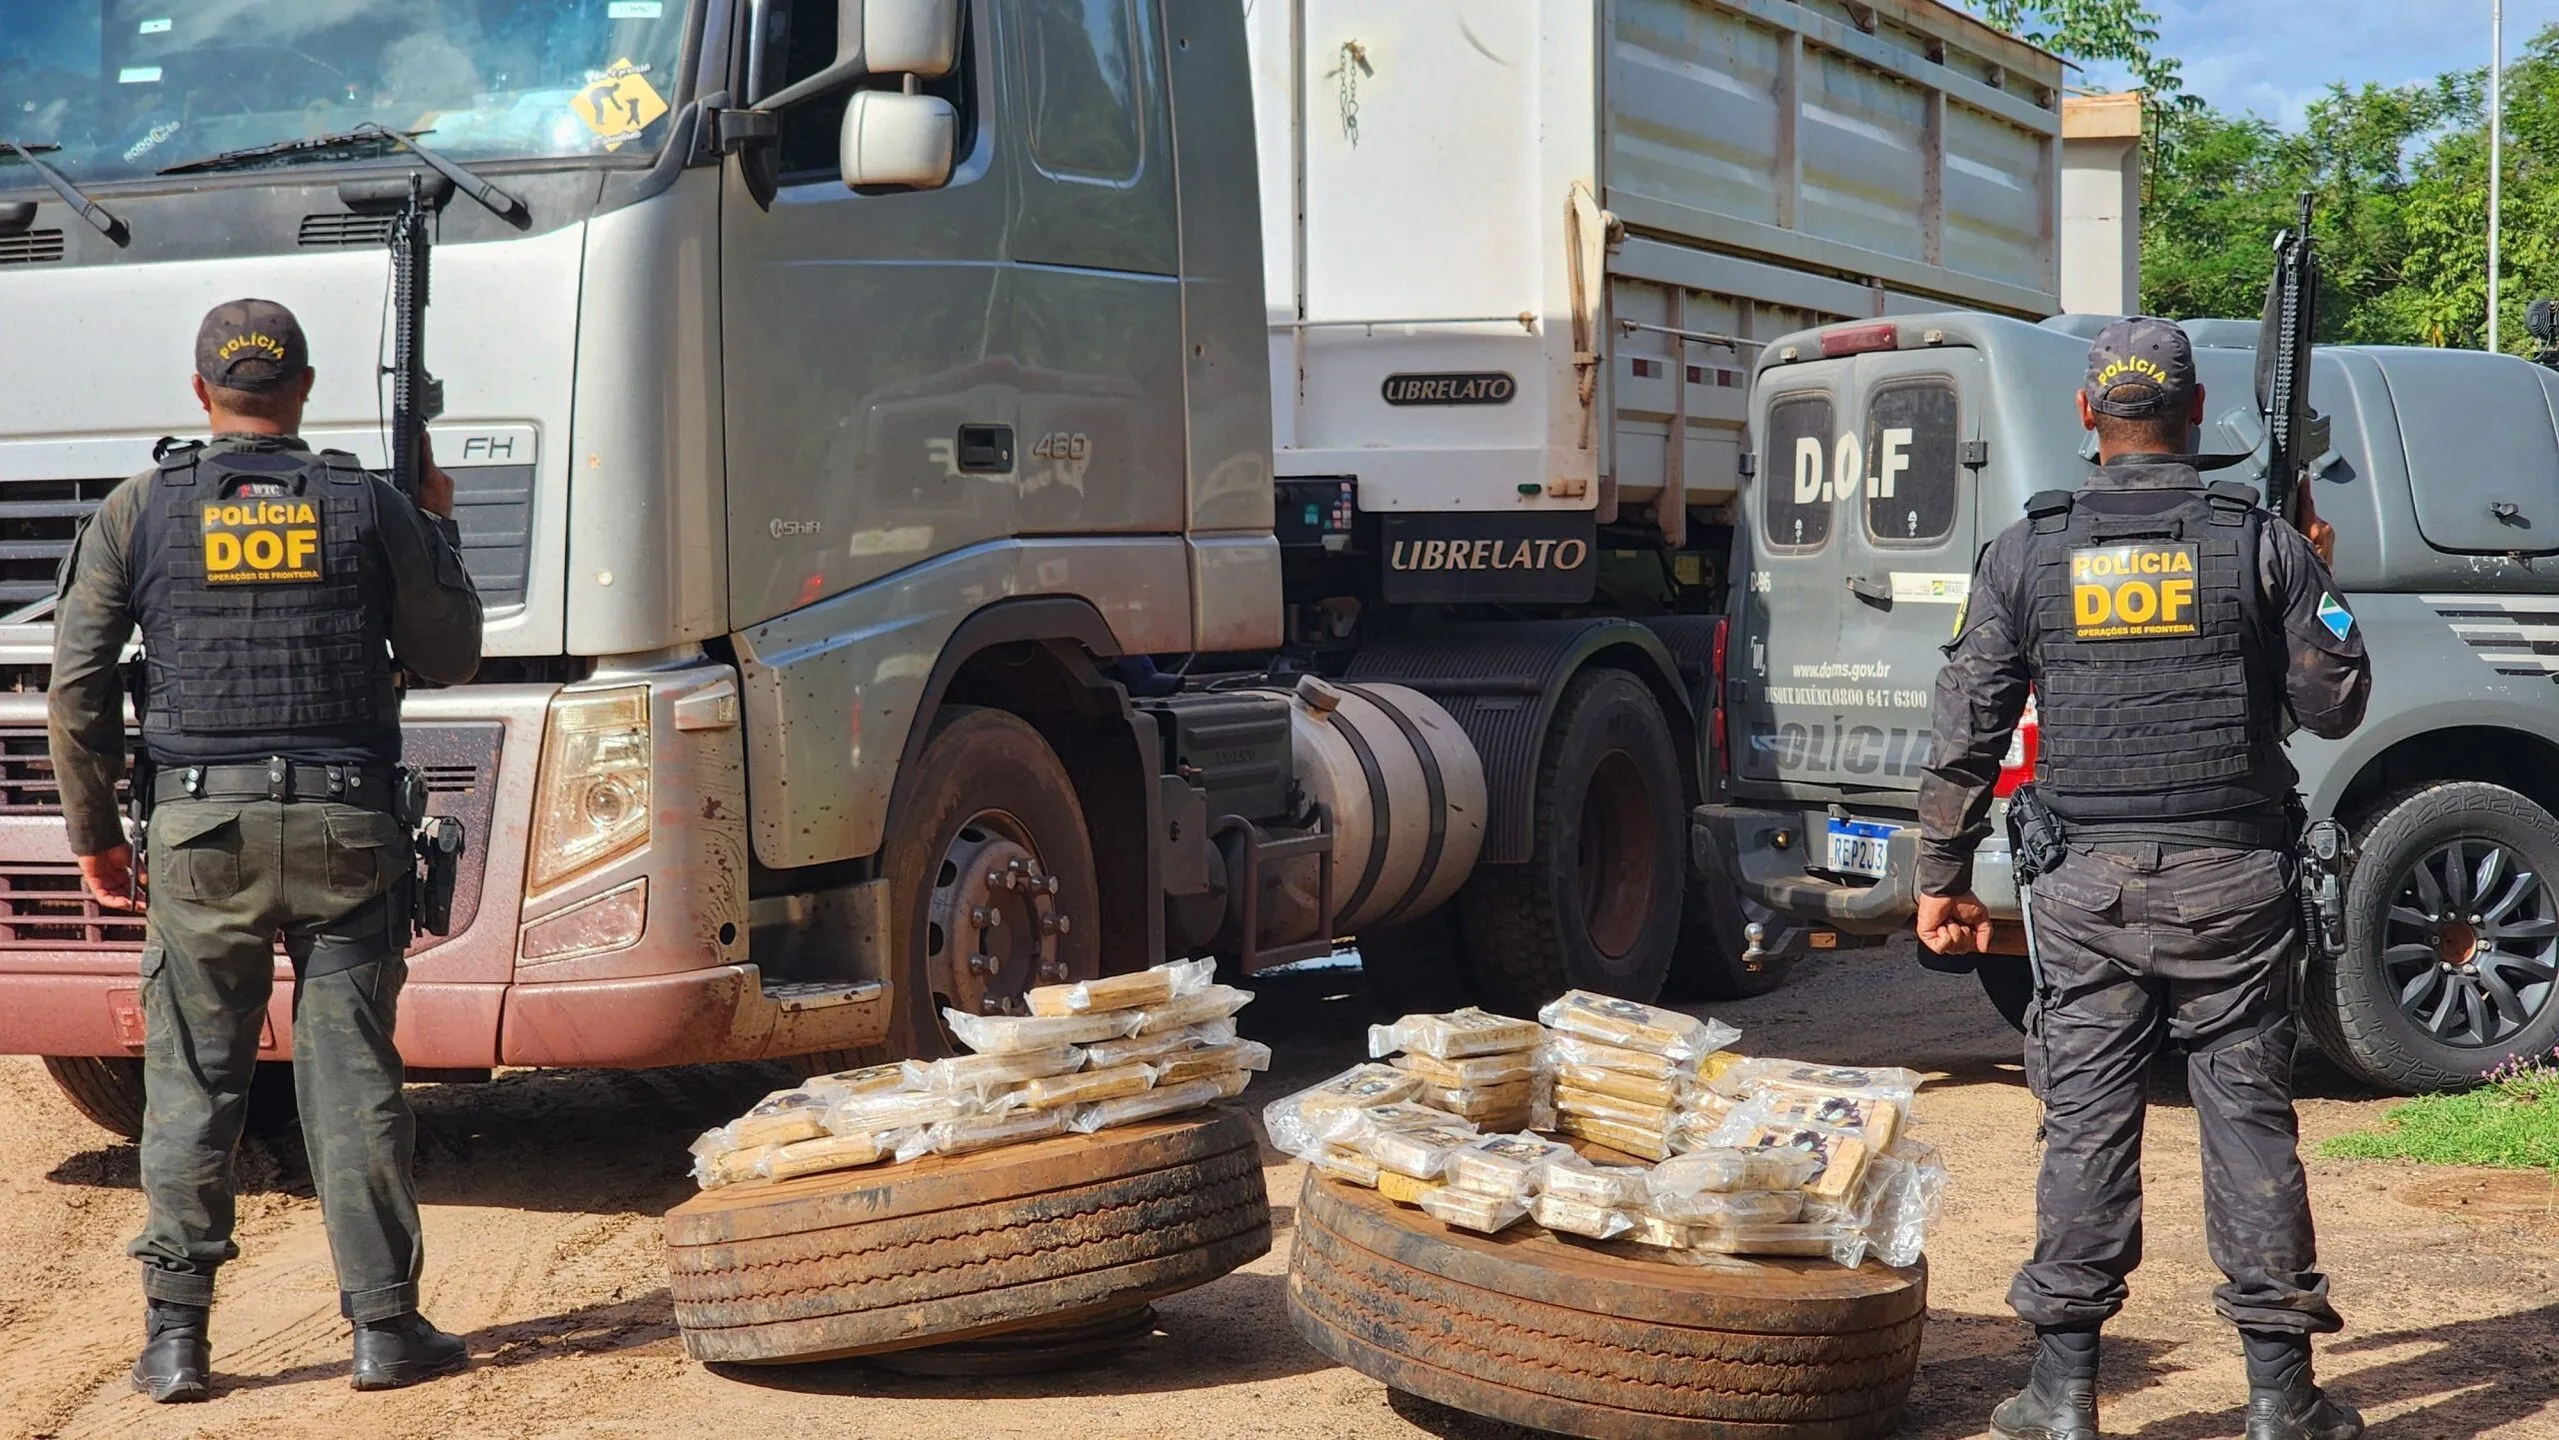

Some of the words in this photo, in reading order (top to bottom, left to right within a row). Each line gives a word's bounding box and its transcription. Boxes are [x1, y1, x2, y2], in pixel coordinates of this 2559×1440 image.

[218, 331, 286, 360] POLÍCIA
[2098, 355, 2167, 386] POLÍCIA
[1386, 378, 1512, 401] LIBRELATO
[463, 436, 514, 459] FH
[1794, 427, 1913, 504] D.O.F
[203, 500, 317, 527] POLÍCIA
[204, 529, 318, 571] DOF
[1391, 538, 1588, 571] LIBRELATO
[2073, 548, 2193, 577] POLÍCIA
[207, 571, 258, 582] OPERAÇÕES
[258, 571, 271, 580] DE
[271, 569, 320, 580] FRONTEIRA
[1750, 571, 1771, 592] D-96
[2074, 579, 2194, 626] DOF
[2077, 626, 2129, 637] OPERAÇÕES
[2130, 626, 2142, 635] DE
[2143, 624, 2195, 634] FRONTEIRA
[1832, 687, 1863, 706] 0800
[1866, 690, 1889, 707] 647
[1893, 690, 1927, 708] 6300
[1835, 838, 1884, 870] REP2J3
